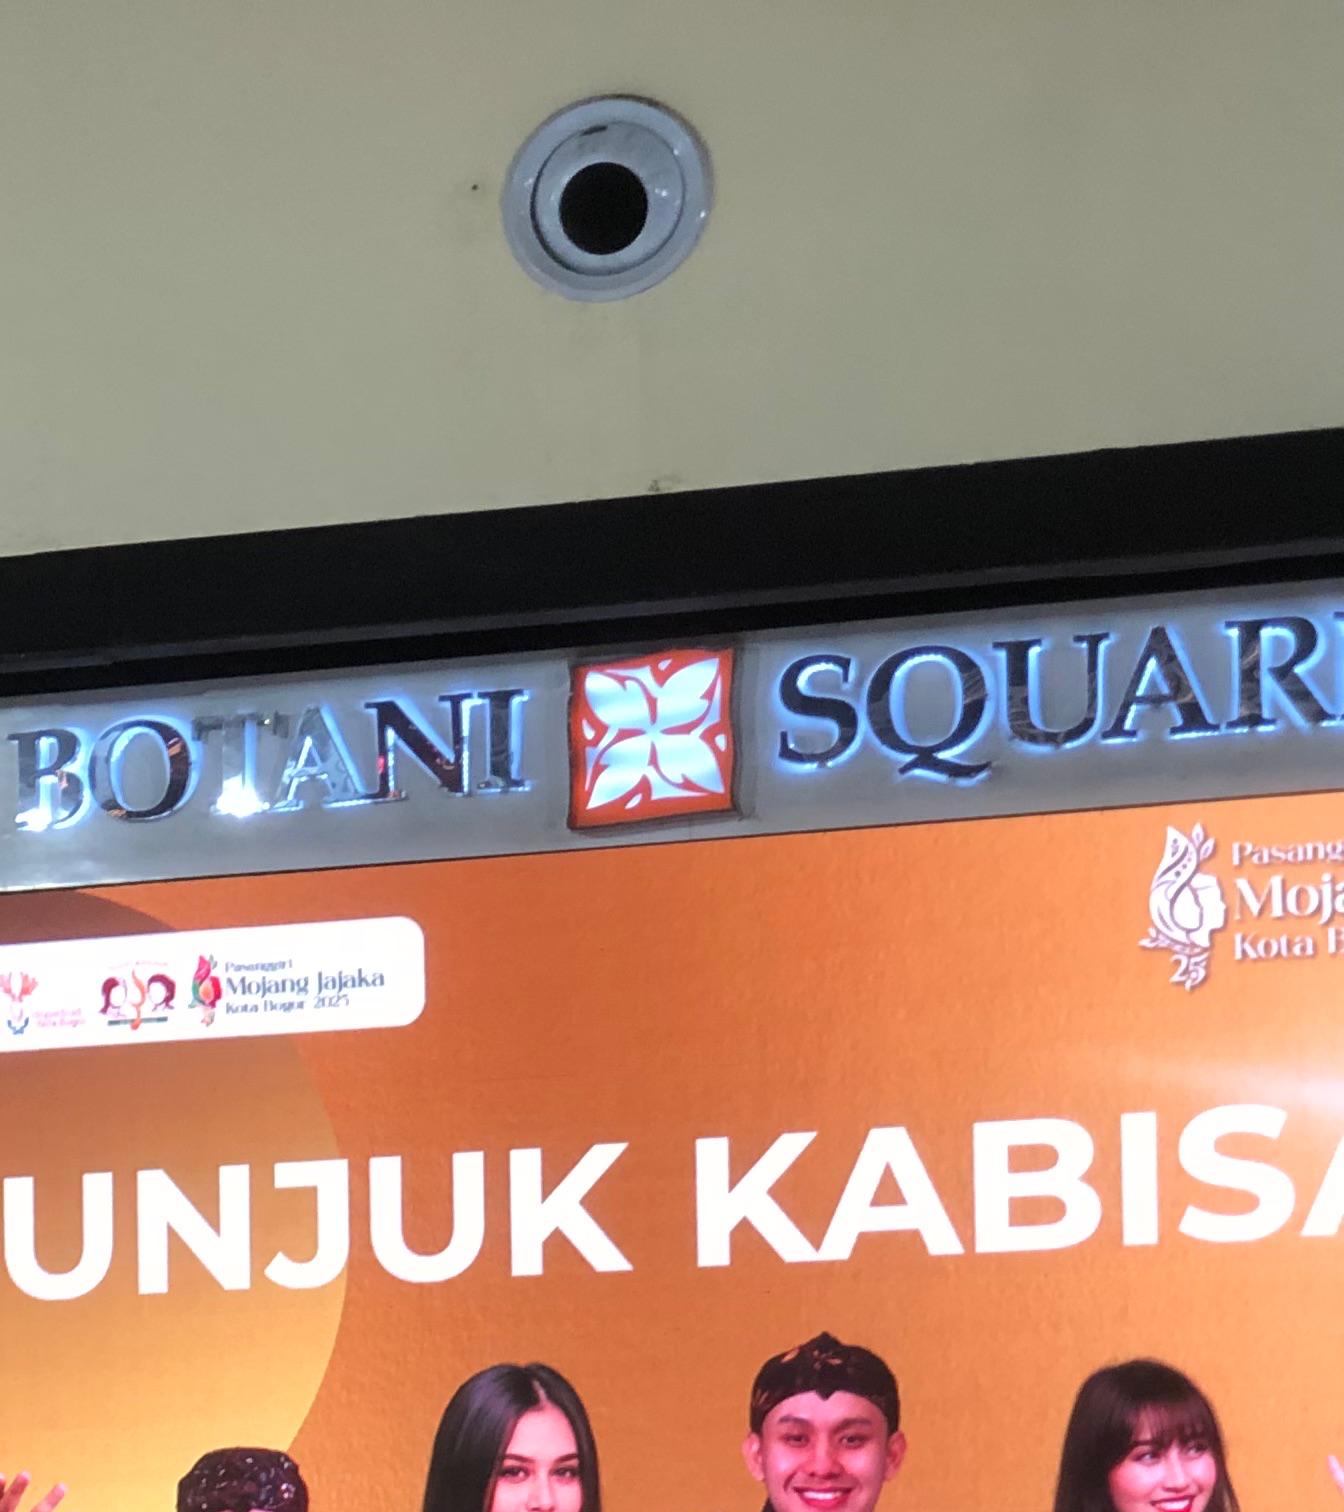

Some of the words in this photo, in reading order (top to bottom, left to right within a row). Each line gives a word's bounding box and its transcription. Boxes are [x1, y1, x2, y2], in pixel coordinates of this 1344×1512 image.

[7, 688, 531, 830] BOTANI
[777, 611, 1344, 780] SQUAR
[1234, 930, 1315, 960] Kota
[226, 975, 309, 998] Mojang
[317, 968, 385, 995] Jajaka
[226, 1001, 259, 1014] Kota
[264, 1000, 305, 1013] Bogor
[3, 1142, 634, 1301] UNJUK
